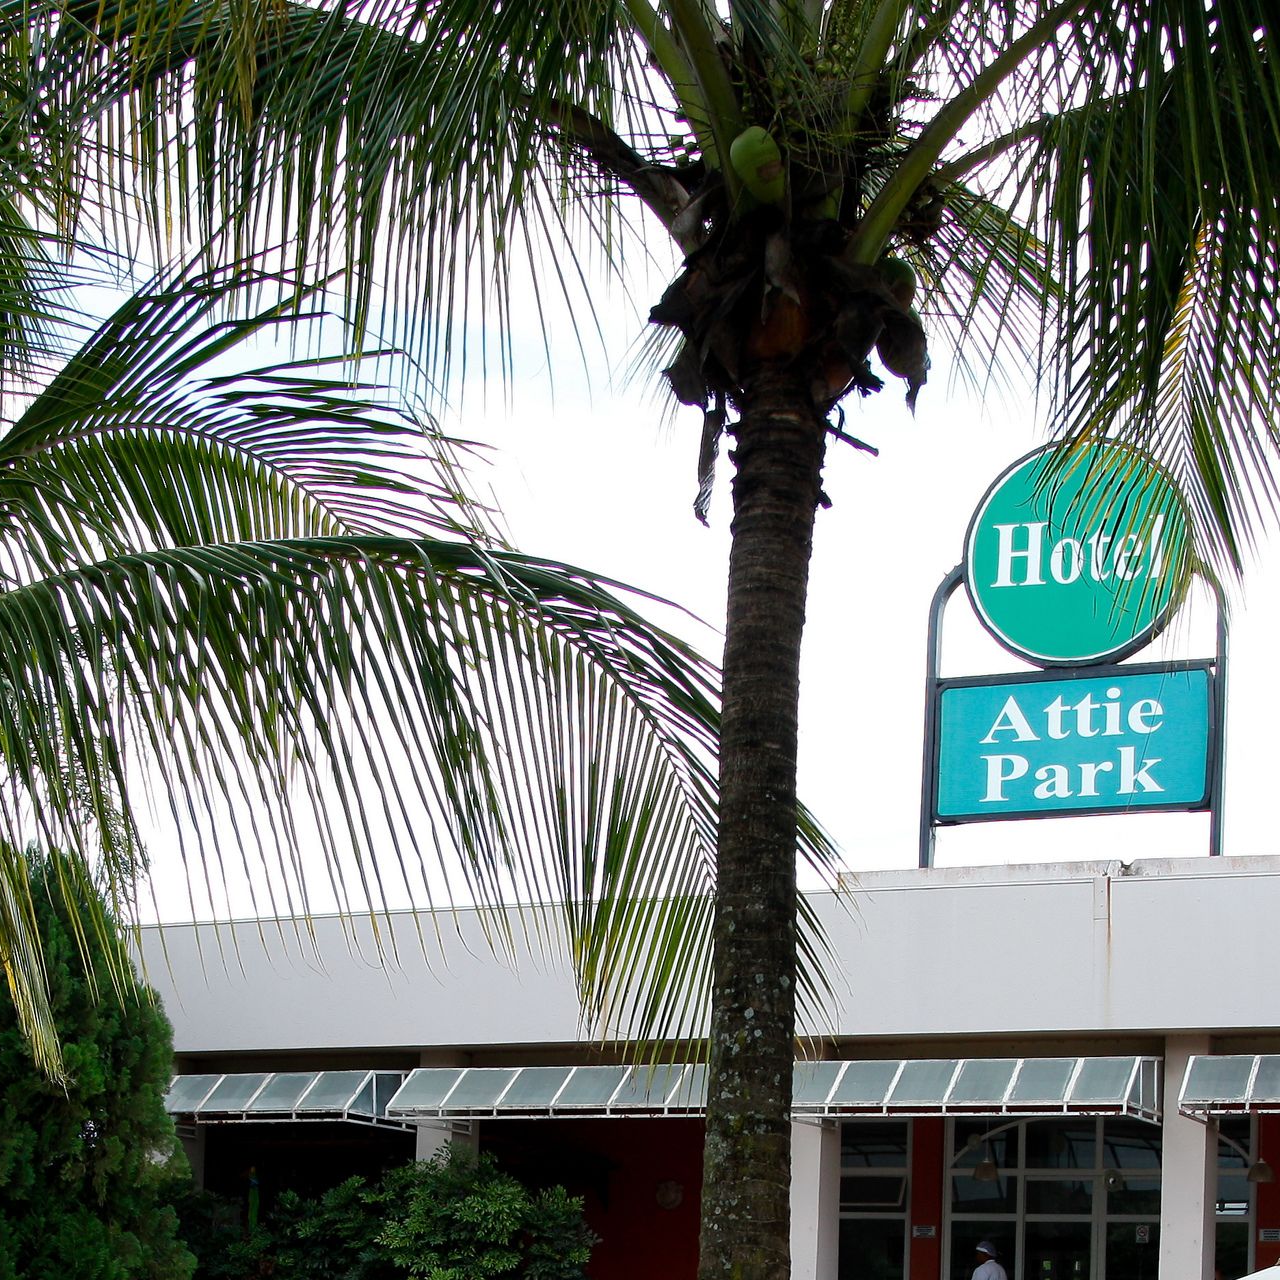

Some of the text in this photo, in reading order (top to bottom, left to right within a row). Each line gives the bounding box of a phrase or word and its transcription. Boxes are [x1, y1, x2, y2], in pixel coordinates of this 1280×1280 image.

[989, 513, 1166, 588] Hotel
[978, 687, 1164, 744] Attie
[978, 746, 1166, 803] Park
